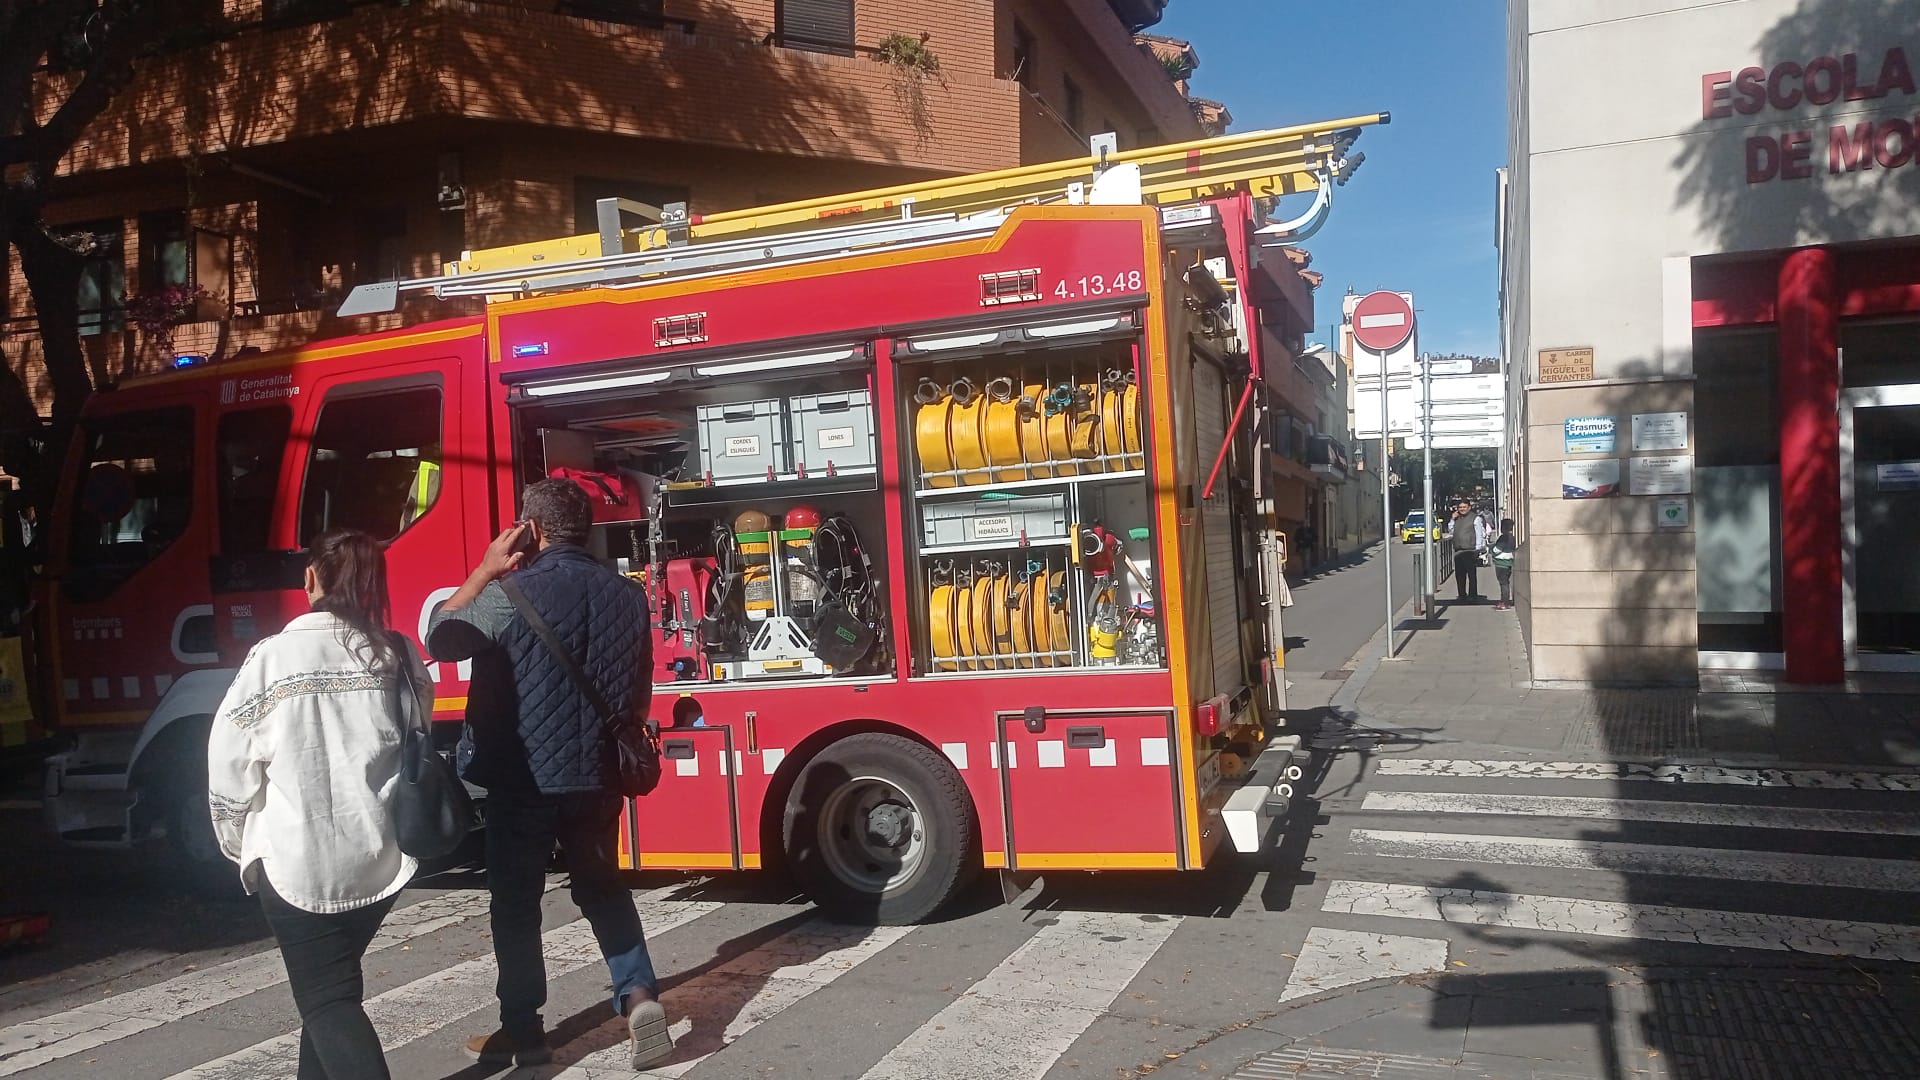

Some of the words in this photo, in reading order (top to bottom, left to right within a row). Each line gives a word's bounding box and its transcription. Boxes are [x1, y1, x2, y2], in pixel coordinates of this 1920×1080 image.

[1701, 47, 1916, 121] ESCOLA
[1745, 130, 1813, 184] DE
[1829, 111, 1920, 175] MO
[1054, 270, 1142, 299] 4.13.48
[1540, 373, 1591, 382] CERVANTES
[1542, 366, 1577, 375] MIGUEL
[240, 373, 293, 390] Generalitat
[239, 392, 251, 402] de
[253, 386, 300, 400] Catalunya
[1569, 423, 1613, 432] Erasmus+
[979, 518, 1007, 526] ACCESORIS
